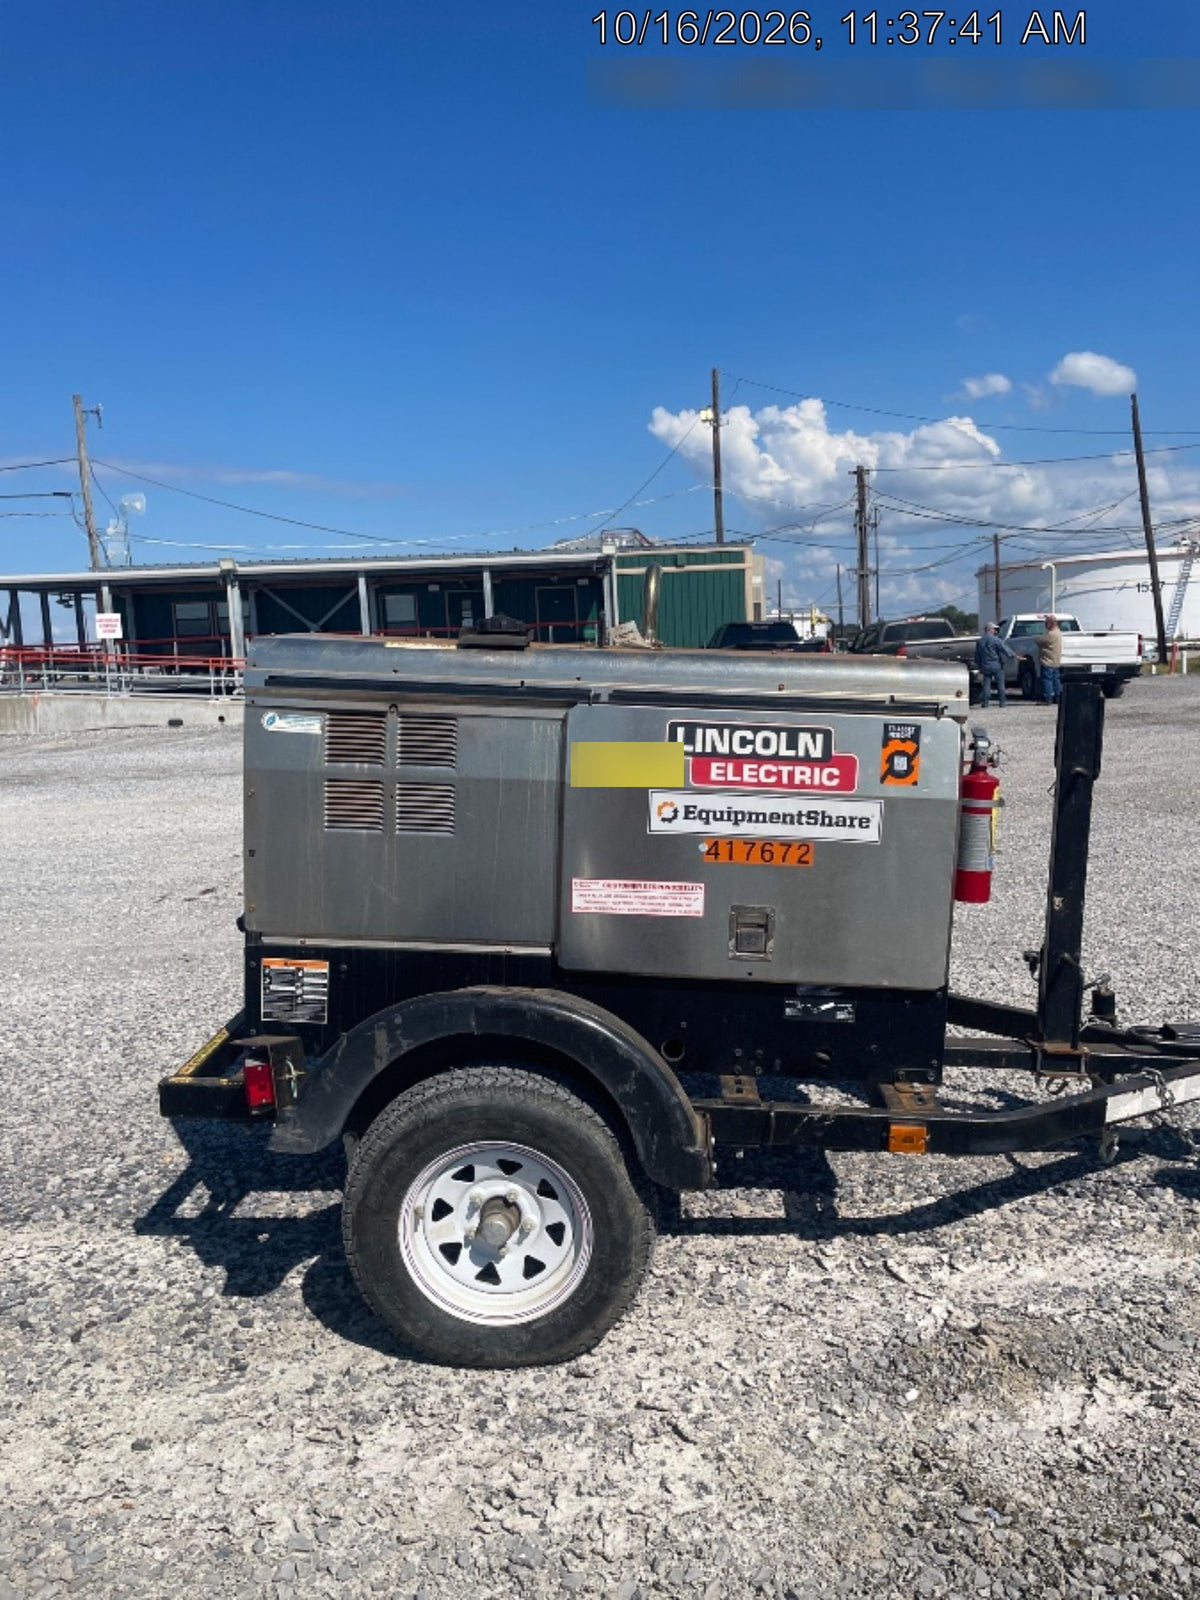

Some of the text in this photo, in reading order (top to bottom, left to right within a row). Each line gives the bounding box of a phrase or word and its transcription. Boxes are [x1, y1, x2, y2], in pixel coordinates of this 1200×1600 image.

[710, 762, 841, 786] ELECTRIC
[682, 805, 871, 829] EquipmentShare
[705, 840, 810, 865] 417672
